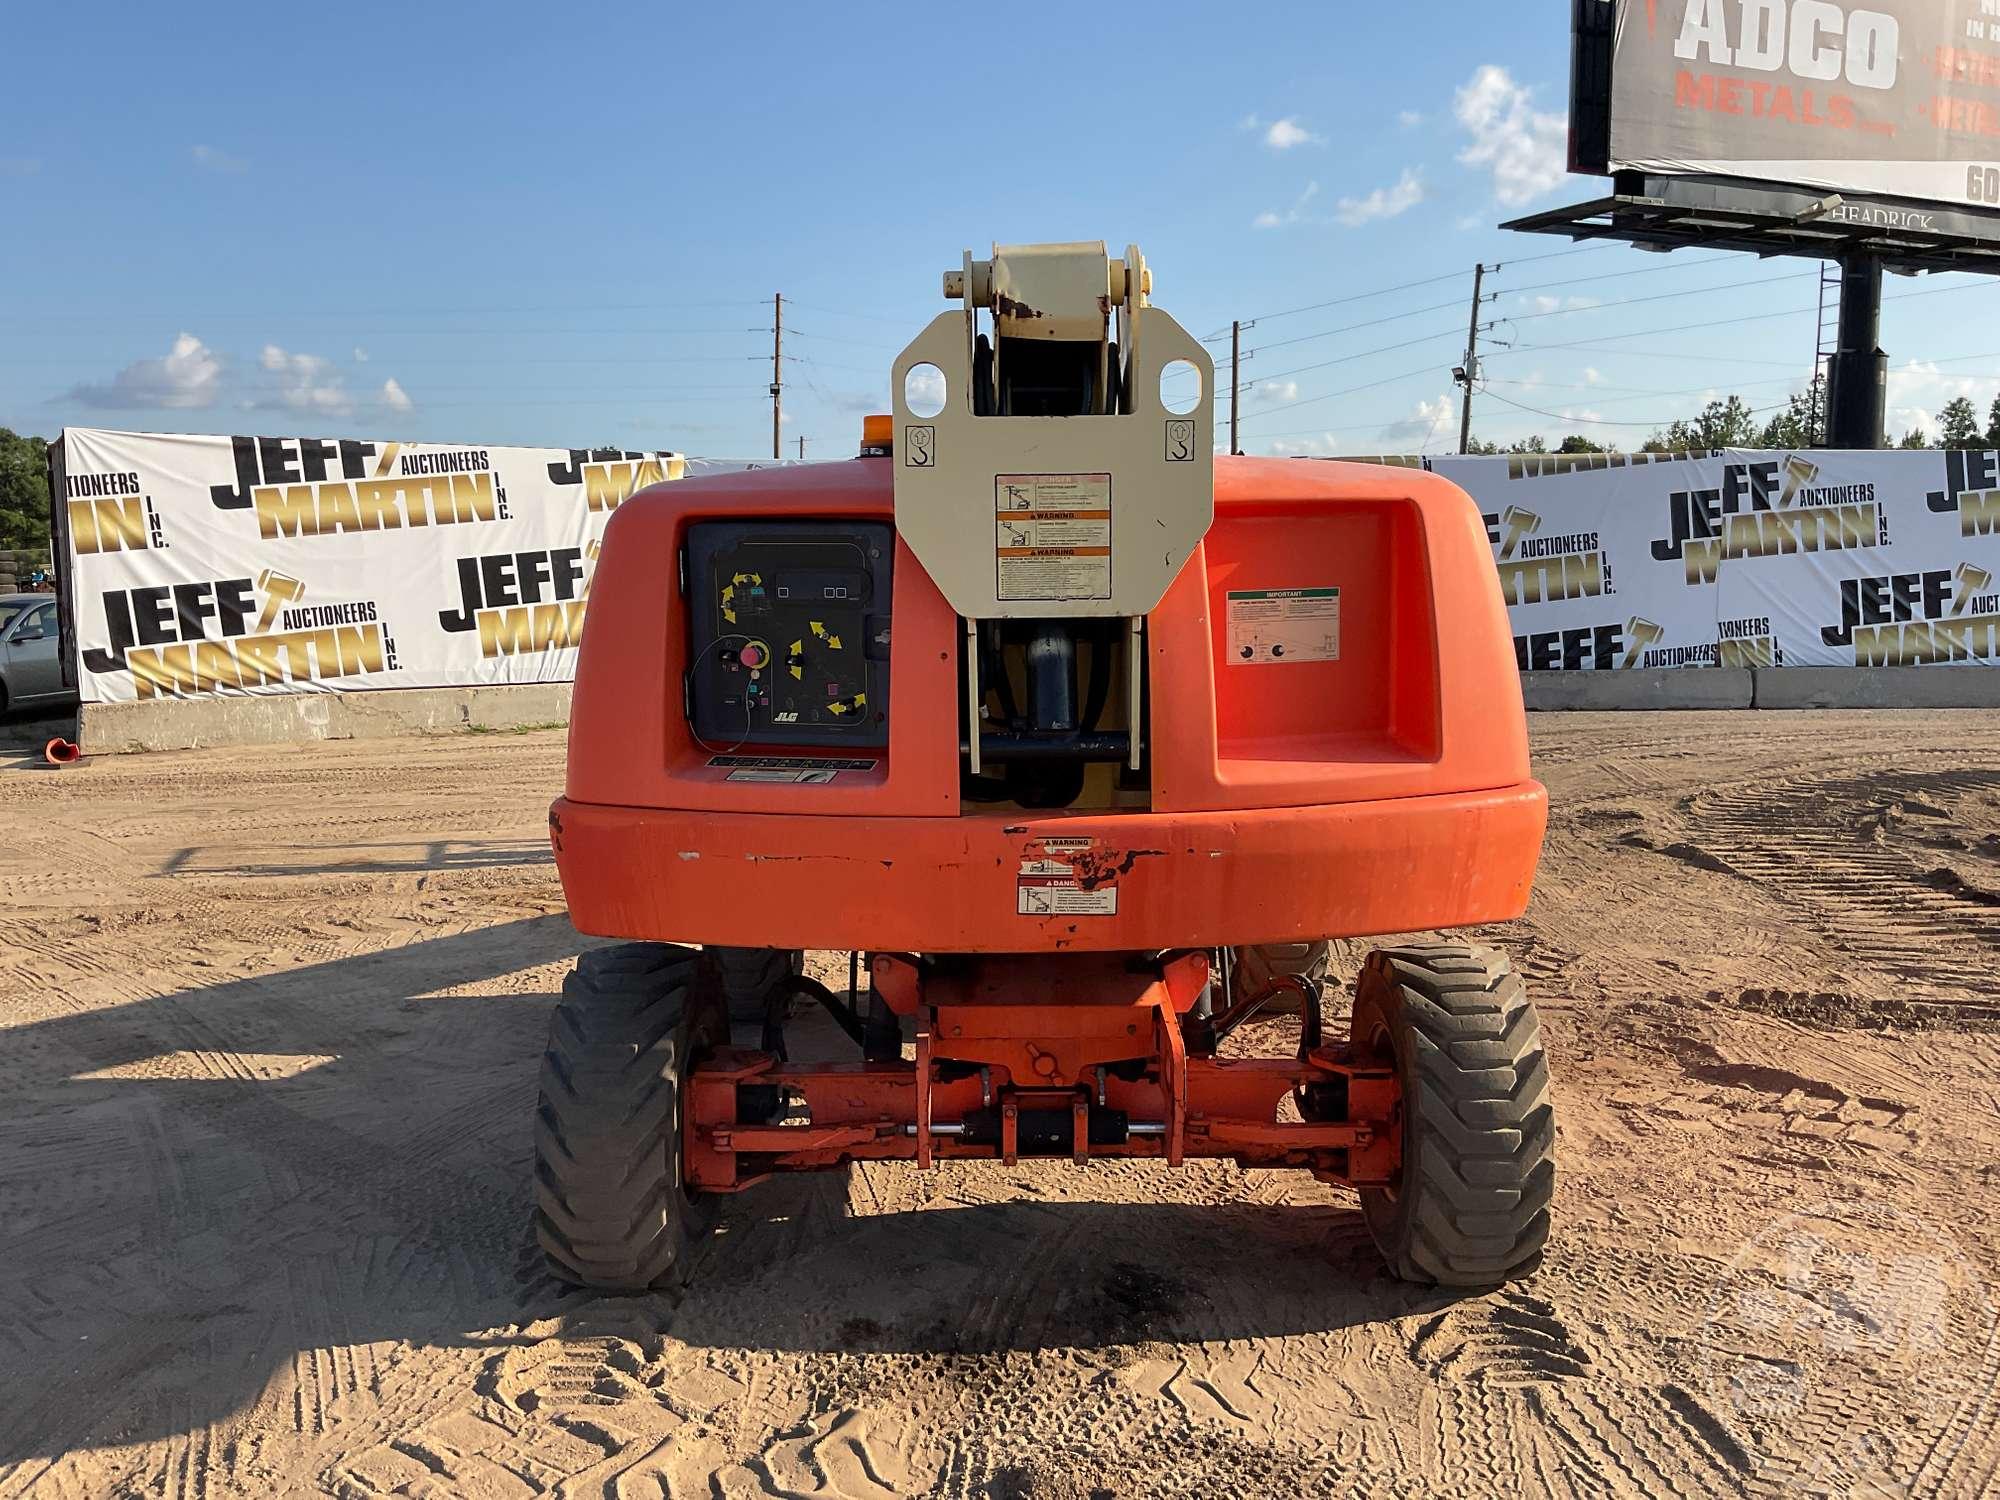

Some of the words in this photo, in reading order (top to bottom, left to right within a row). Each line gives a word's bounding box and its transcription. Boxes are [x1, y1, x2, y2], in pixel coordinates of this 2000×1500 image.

[1674, 0, 1899, 90] ADCO
[1675, 71, 1856, 129] METALS
[1832, 205, 1933, 229] HEADRICK
[209, 436, 377, 510] JEFF
[401, 451, 490, 476] AUCTIONEERS
[254, 473, 495, 540] MARTIN
[1800, 483, 1875, 507] AUCTIONEERS
[1521, 532, 1598, 559] AUCTIONEERS
[1685, 504, 1876, 585] MARTIN
[283, 602, 377, 630] AUCTIONEERS
[439, 547, 584, 632] JEFF
[1821, 570, 1952, 647] JEFF
[82, 578, 256, 673] JEFF
[1643, 643, 1718, 668] AUCTIONEERS
[128, 624, 384, 700] MARTIN
[774, 712, 799, 722] JLG
